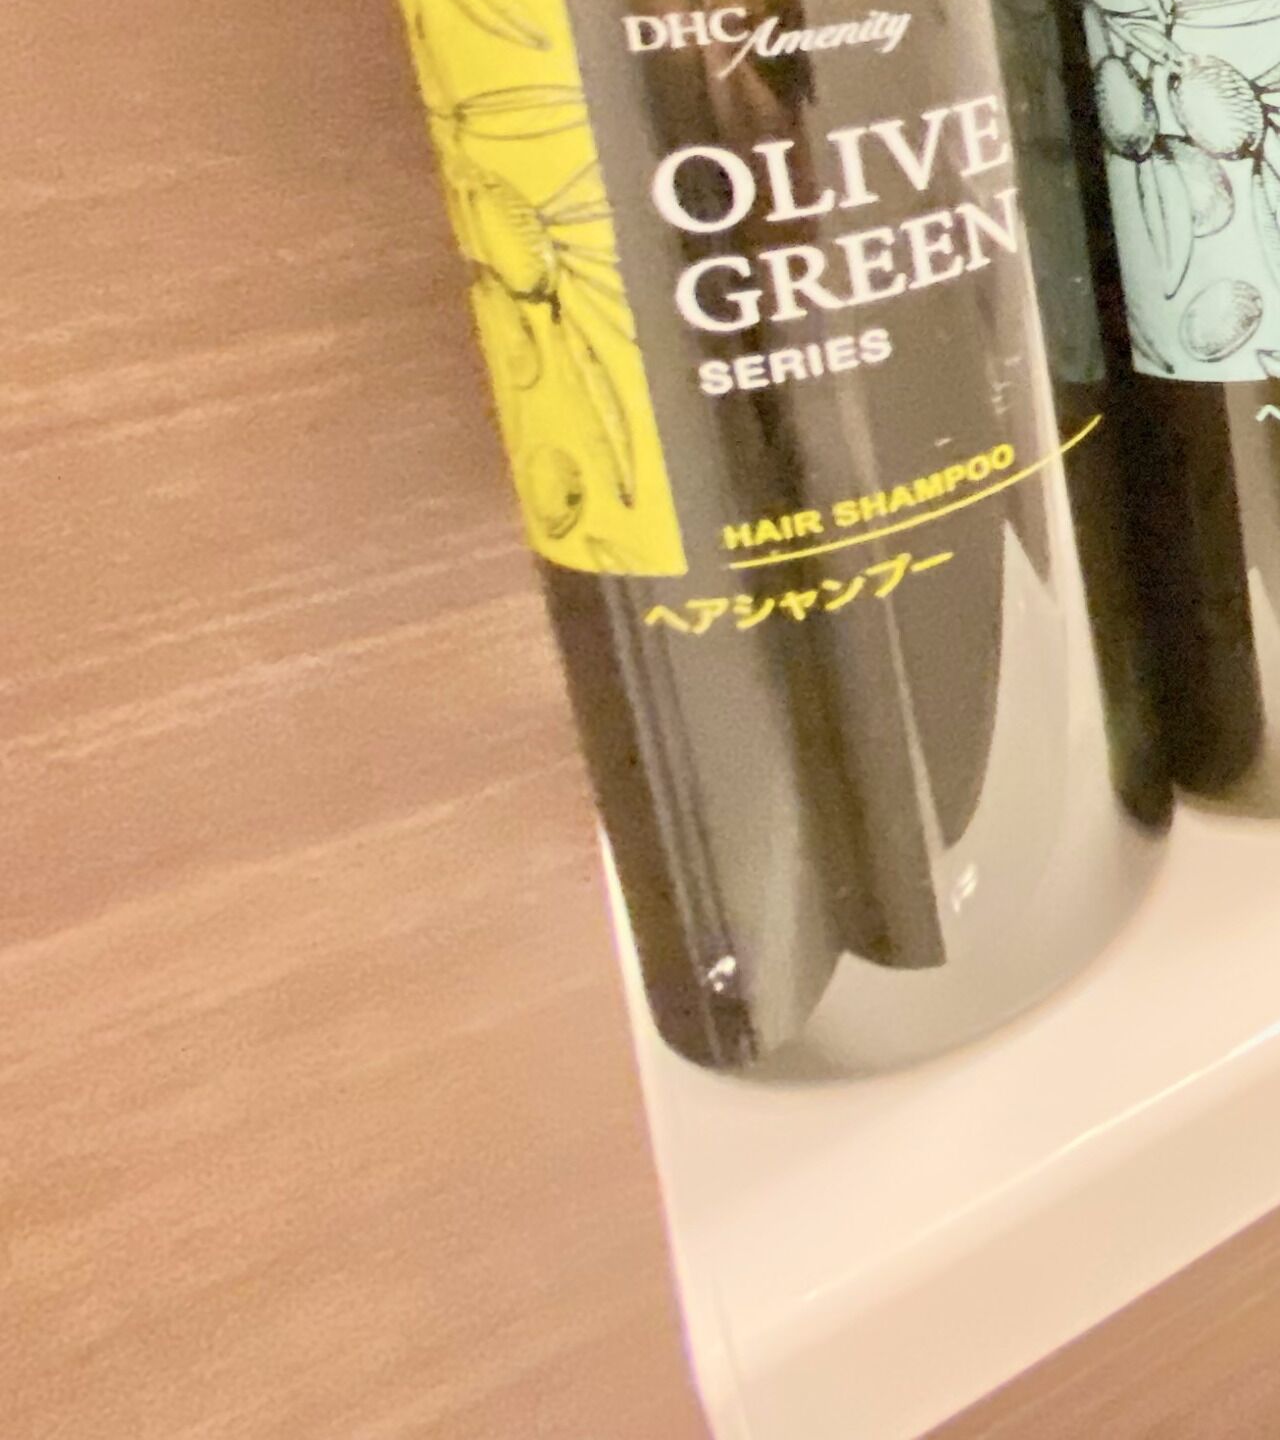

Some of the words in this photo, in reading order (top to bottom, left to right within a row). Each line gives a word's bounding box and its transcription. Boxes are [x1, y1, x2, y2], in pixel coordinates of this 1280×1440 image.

[620, 6, 749, 52] DHC
[716, 9, 912, 80] Amenity
[650, 93, 1010, 233] OLIVE
[675, 187, 1021, 333] GREEN
[698, 327, 894, 397] SERIES
[721, 509, 825, 550] HAIR
[830, 442, 1016, 528] SHAMPOO
